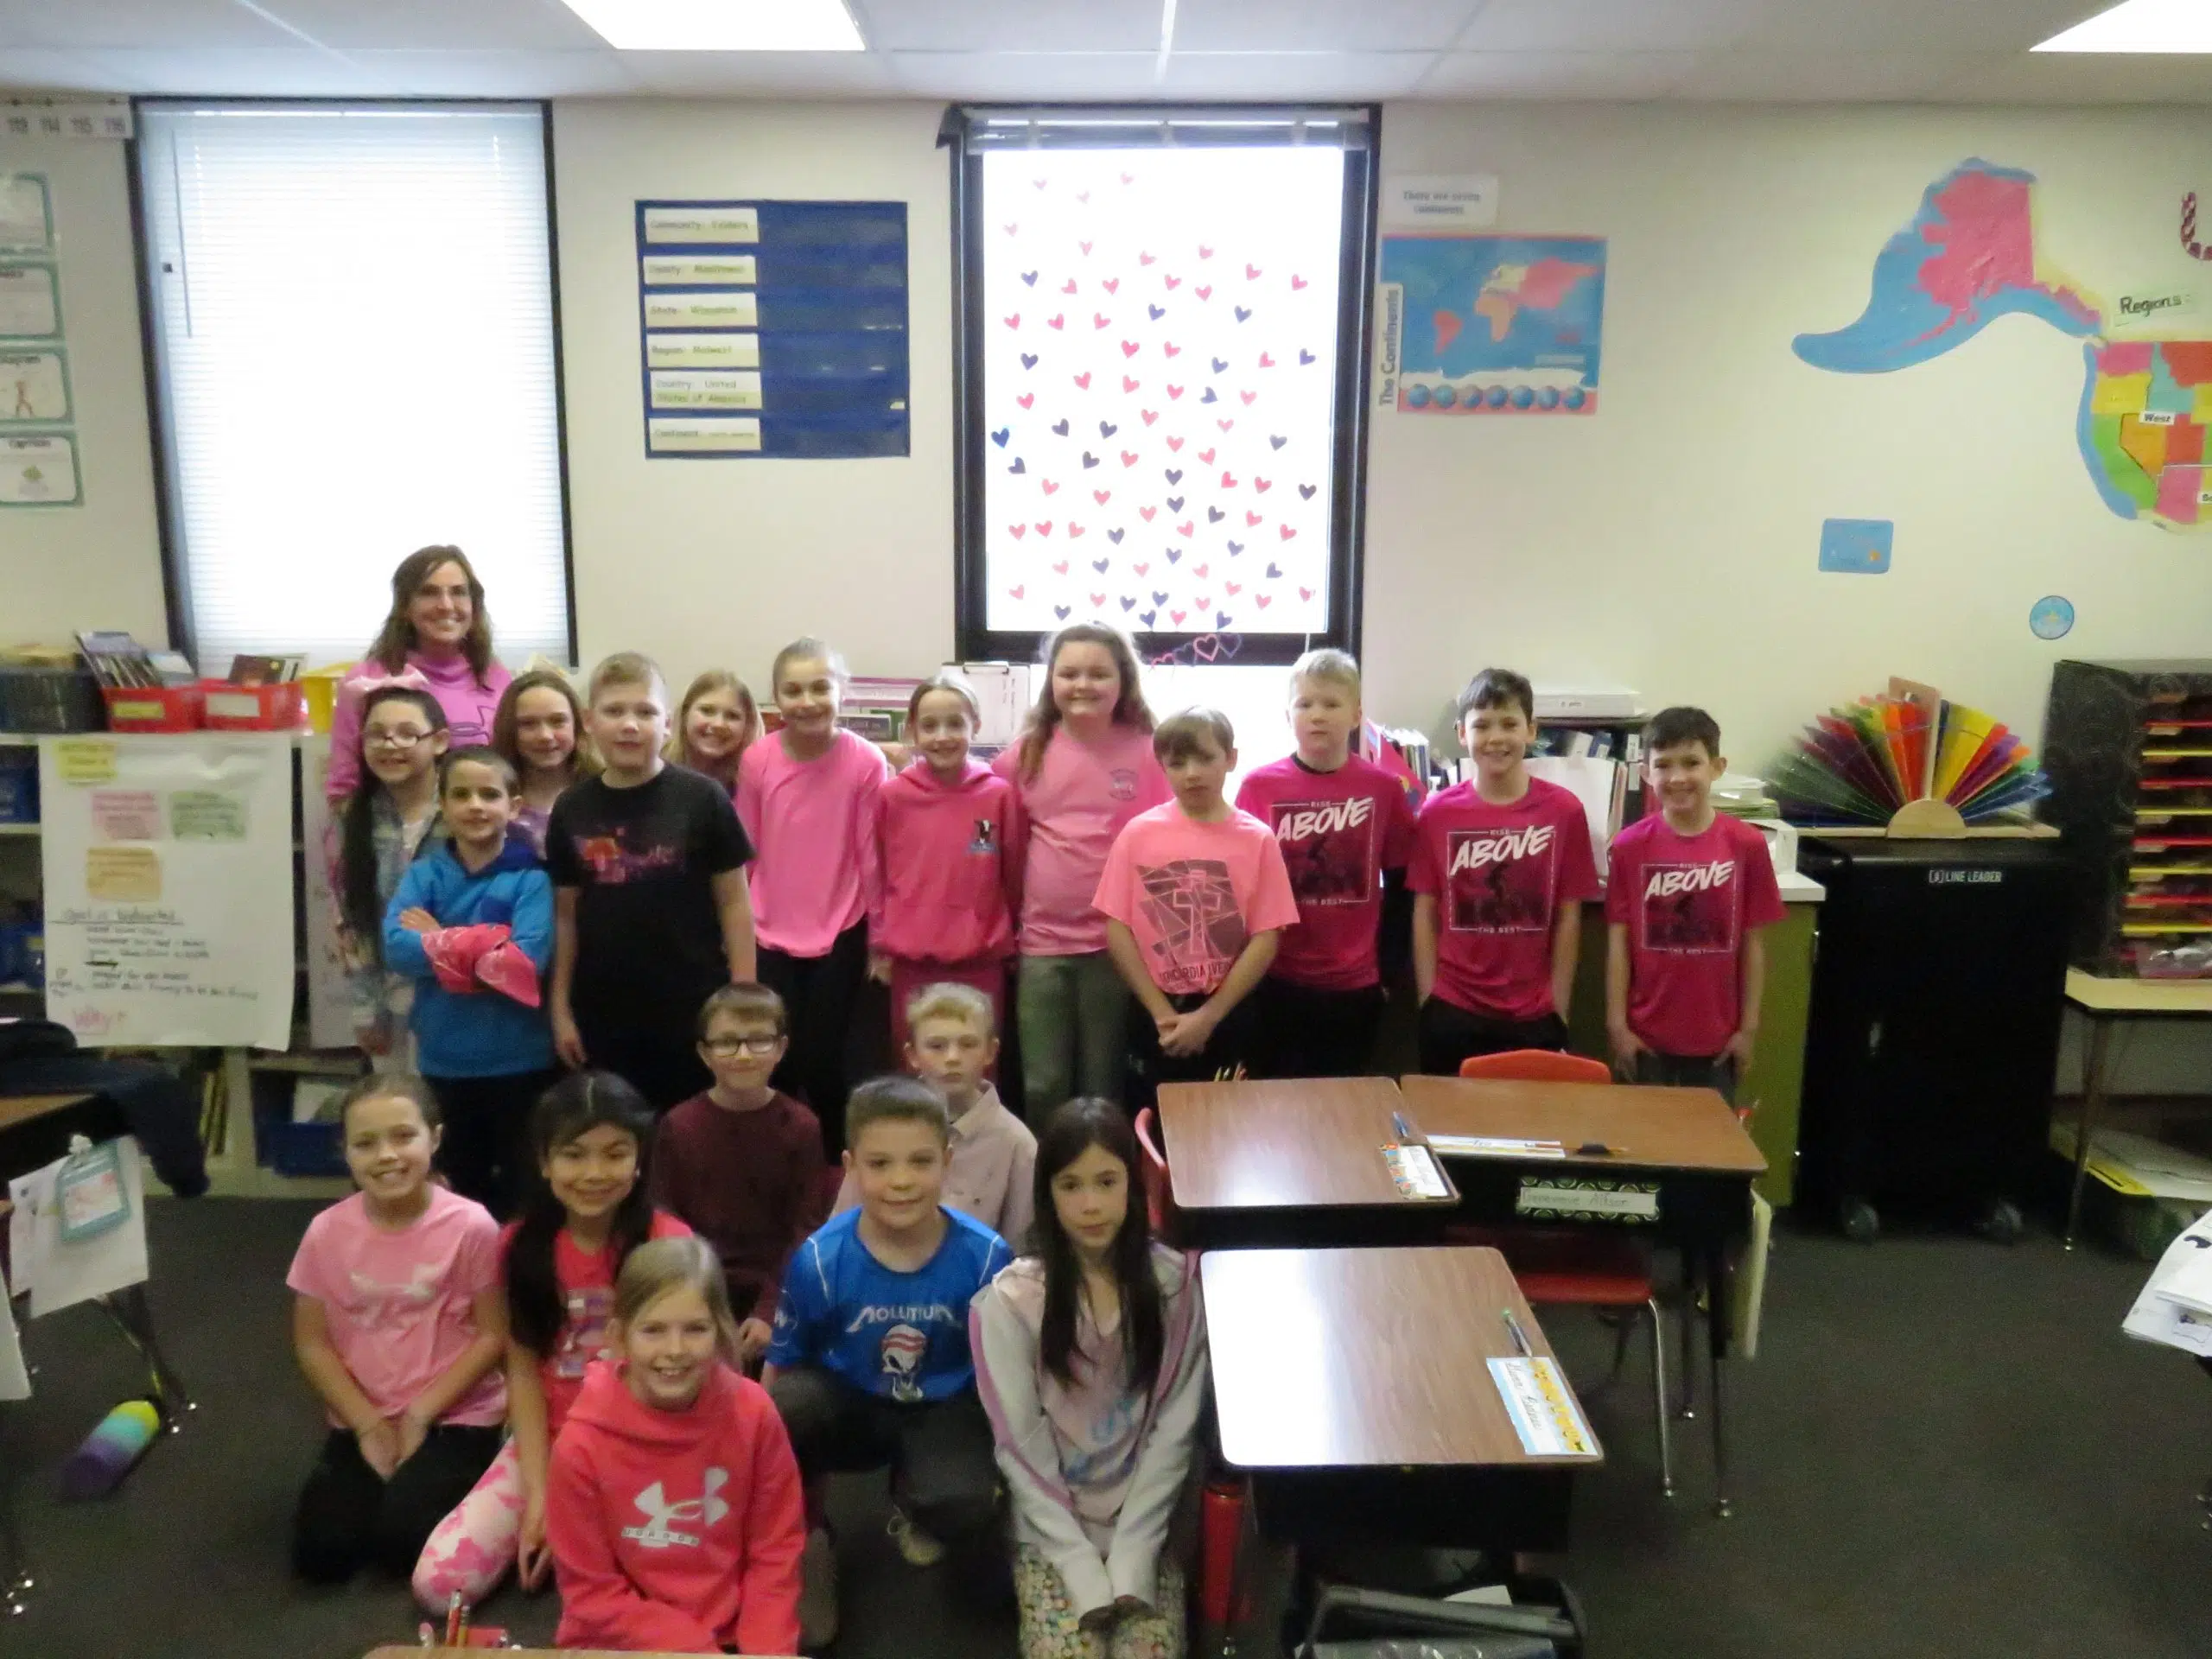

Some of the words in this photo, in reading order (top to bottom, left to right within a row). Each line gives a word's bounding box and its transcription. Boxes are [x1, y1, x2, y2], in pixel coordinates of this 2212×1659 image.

[1379, 378, 1394, 406] The
[2144, 413, 2171, 422] West
[1275, 797, 1374, 844] ABOVE
[1450, 825, 1555, 877] ABOVE
[1644, 860, 1735, 901] ABOVE
[1945, 871, 1966, 882] LINE
[1967, 871, 2002, 882] LEADER
